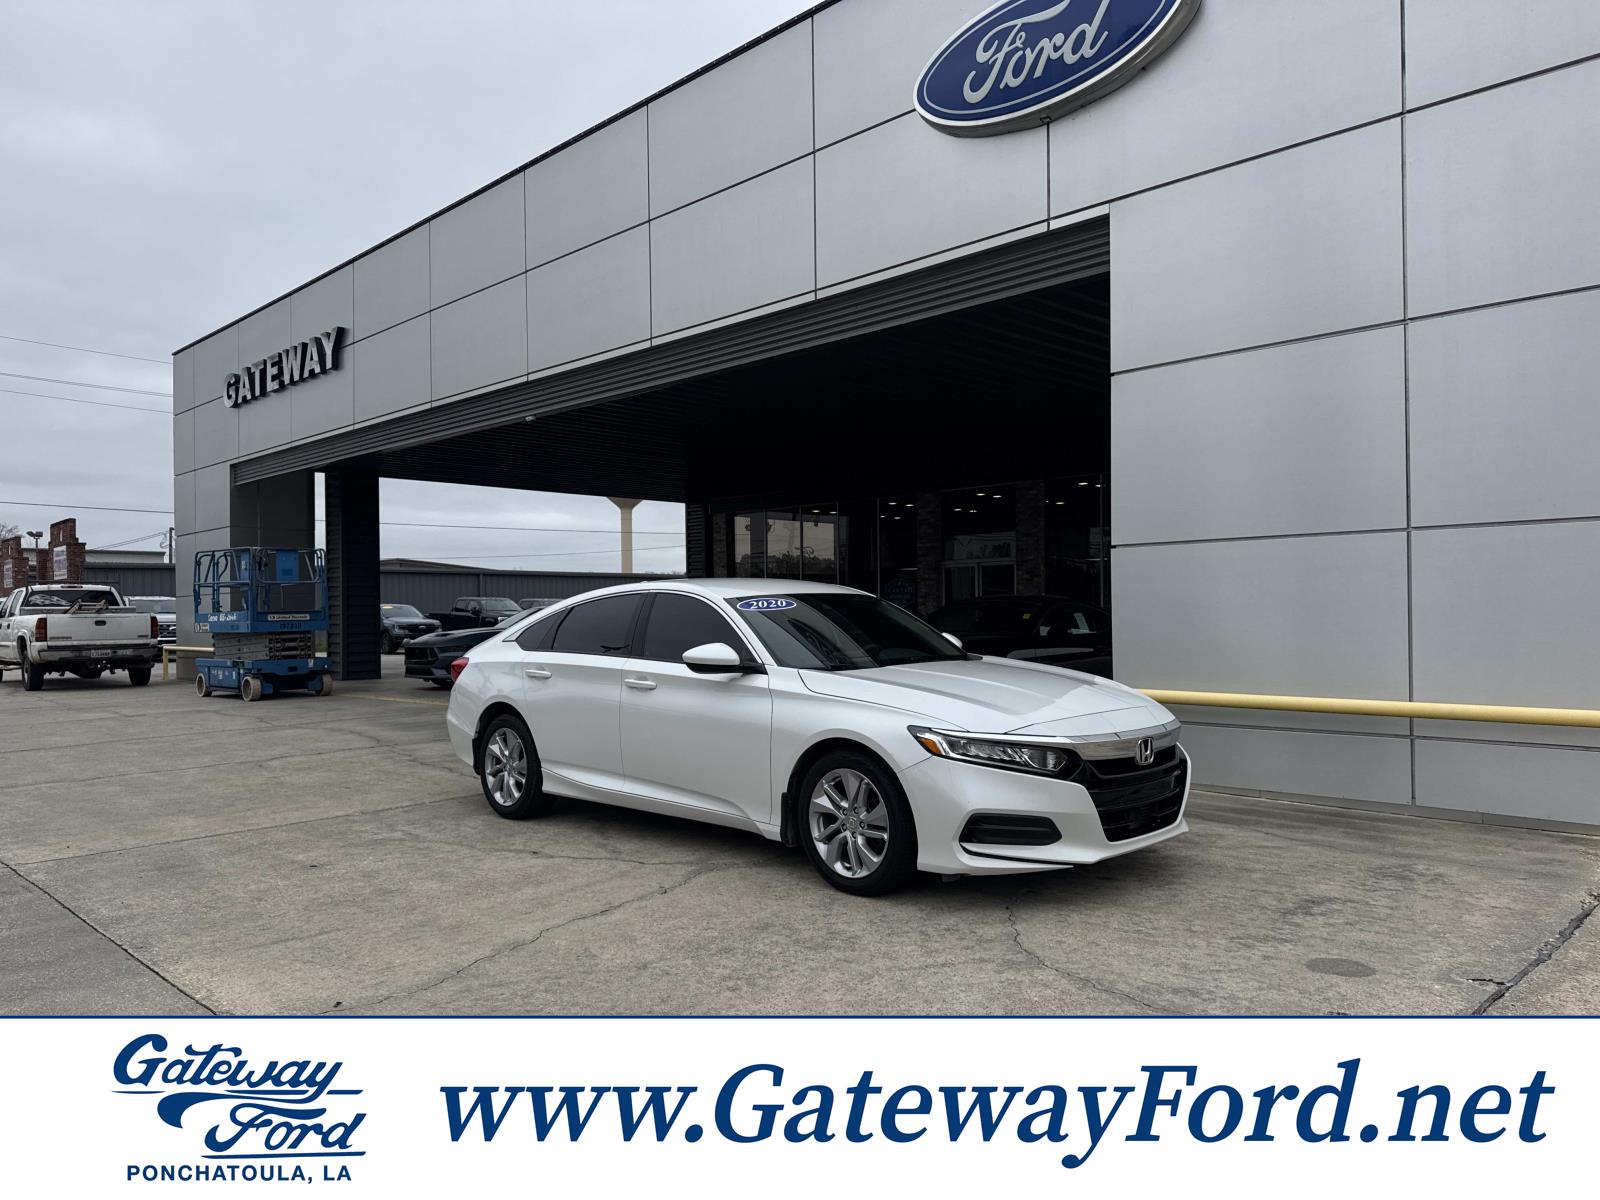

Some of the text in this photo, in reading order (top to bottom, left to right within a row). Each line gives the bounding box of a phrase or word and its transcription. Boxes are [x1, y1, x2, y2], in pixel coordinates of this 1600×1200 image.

[963, 0, 1108, 103] Ford
[223, 326, 345, 408] GATEWAY
[749, 599, 787, 609] 2020
